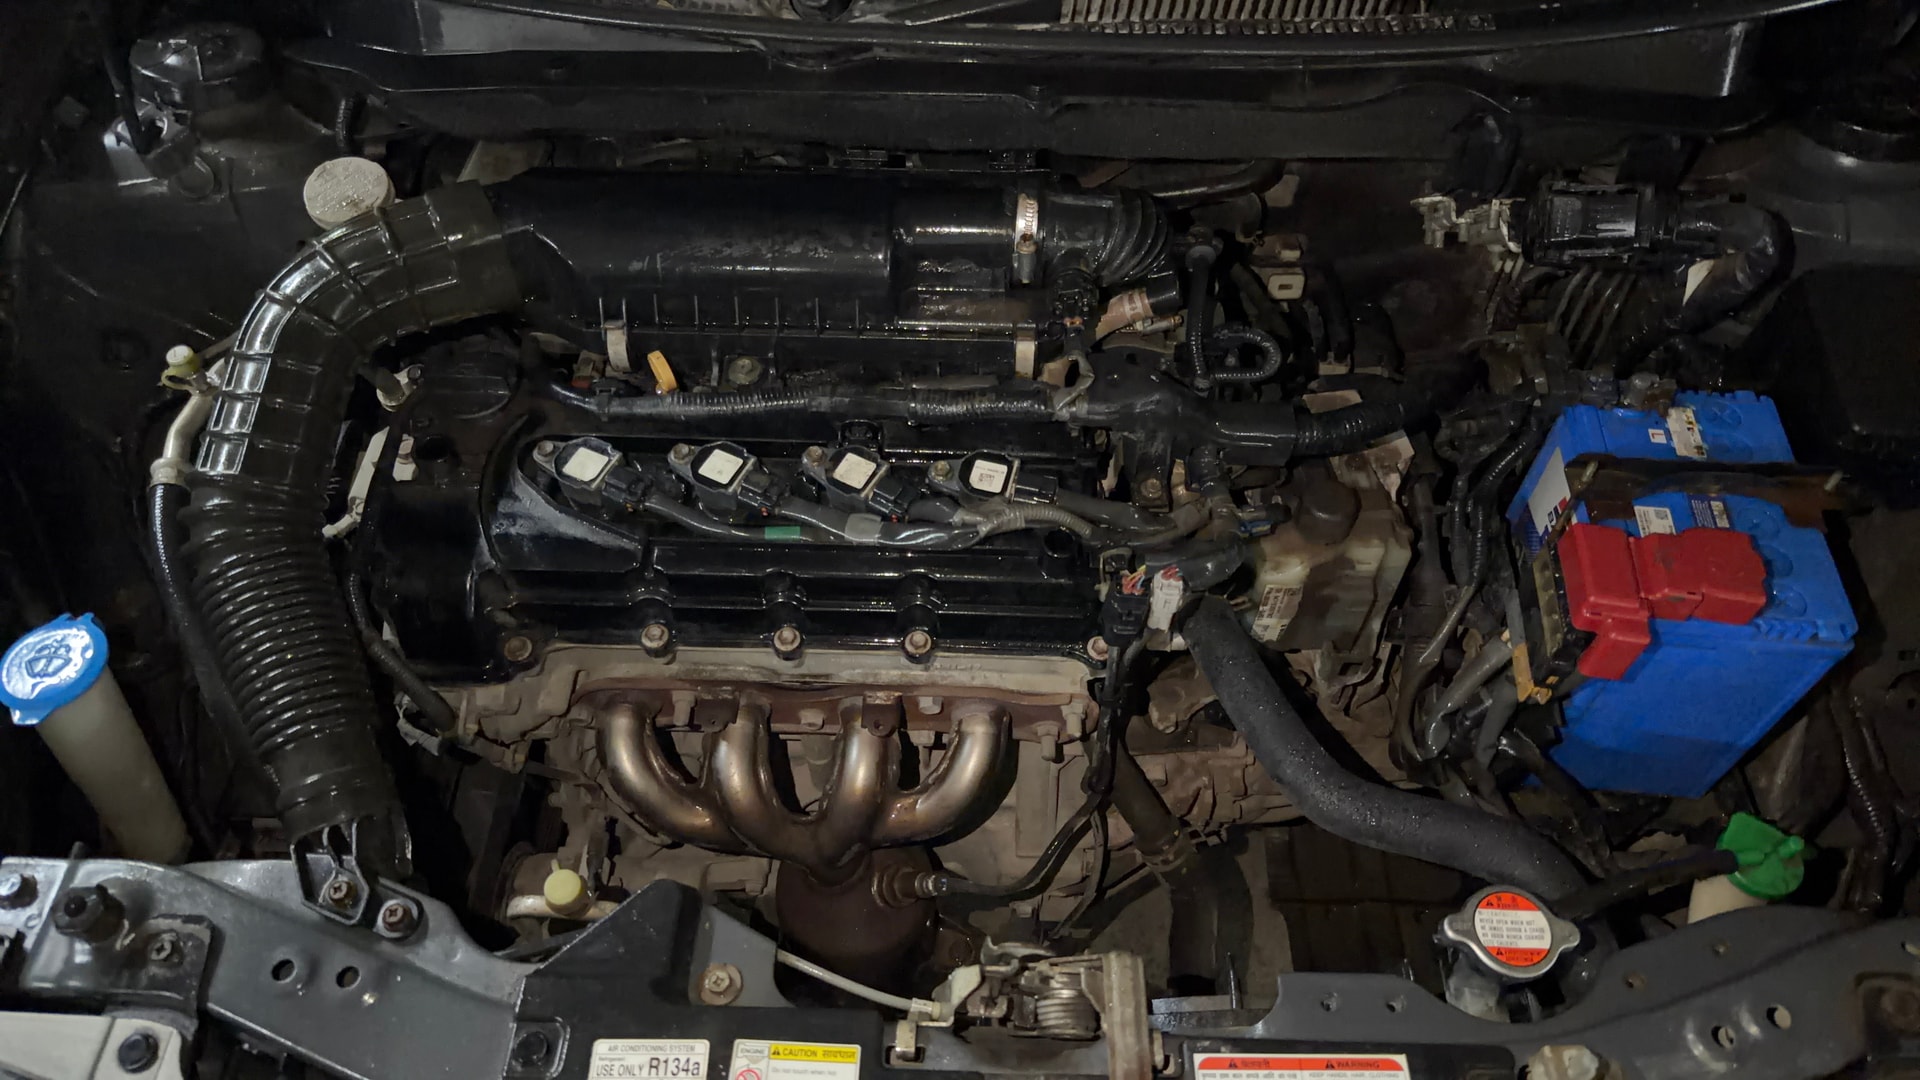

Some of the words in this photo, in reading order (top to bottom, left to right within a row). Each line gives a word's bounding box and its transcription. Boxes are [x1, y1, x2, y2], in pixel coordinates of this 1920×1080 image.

[620, 1044, 668, 1052] CONDITIONING
[669, 1044, 696, 1052] SYSTEM
[740, 1047, 766, 1055] ENGINE
[782, 1047, 818, 1057] CAUTION
[596, 1064, 615, 1077] USE
[617, 1064, 645, 1077] ONLY
[647, 1057, 701, 1077] R134a
